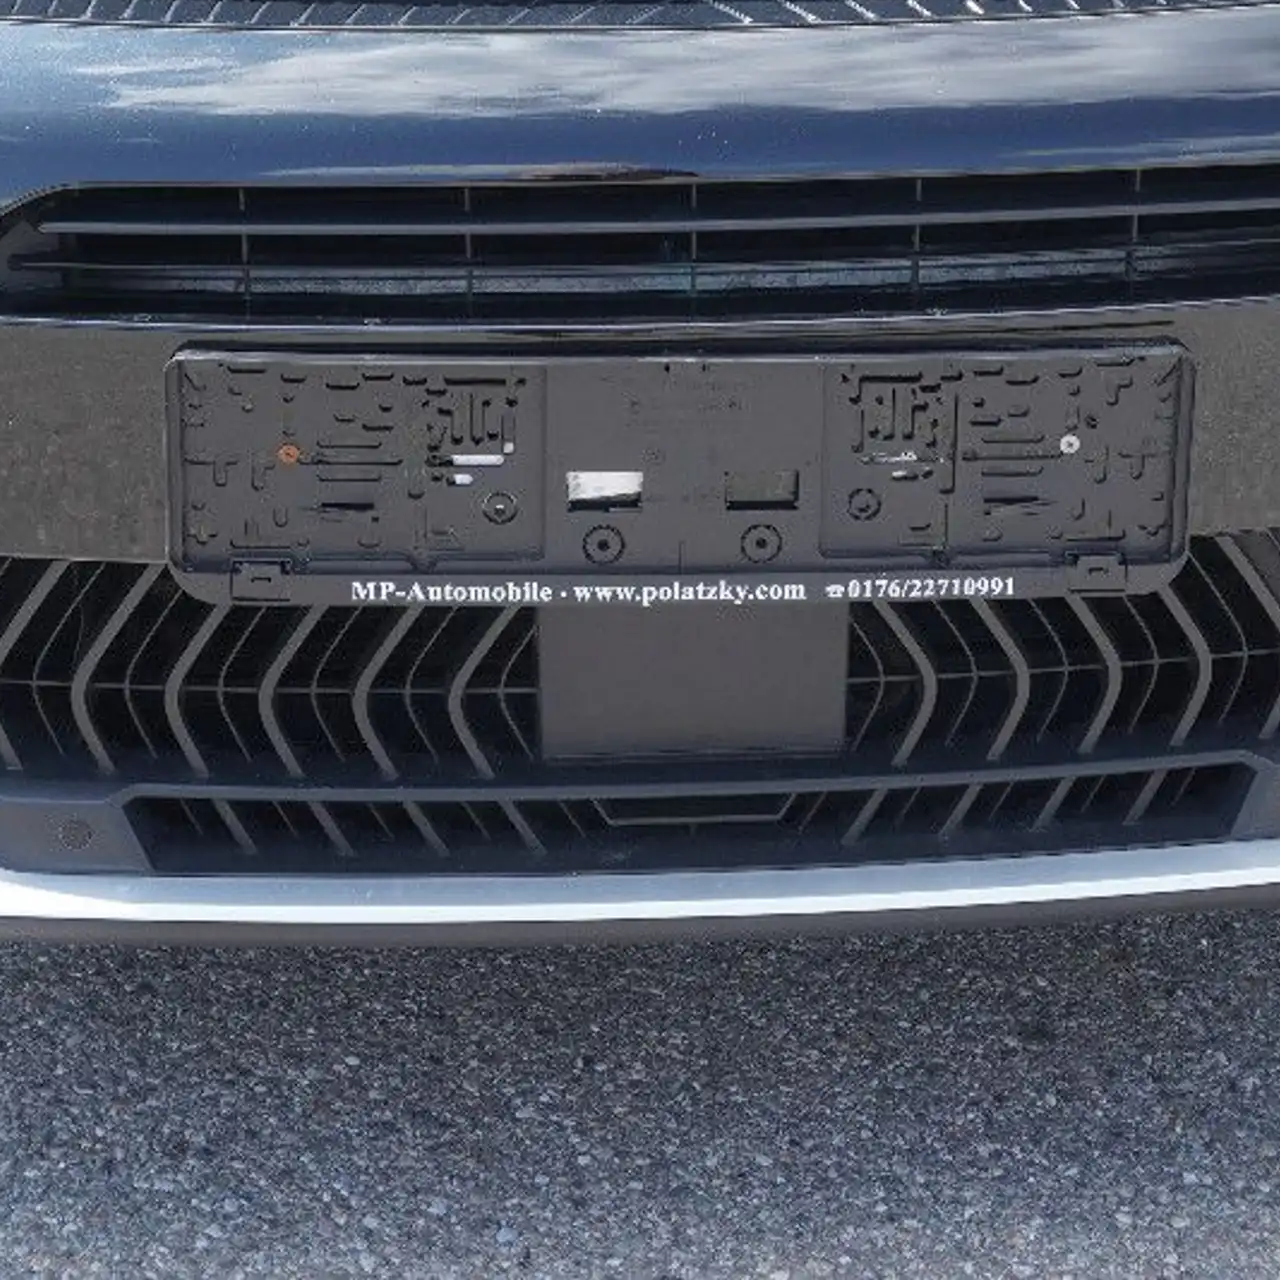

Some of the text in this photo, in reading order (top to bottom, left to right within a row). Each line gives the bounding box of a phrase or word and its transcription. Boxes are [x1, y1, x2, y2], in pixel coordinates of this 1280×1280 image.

[351, 576, 1014, 607] MP-Automobile www.polatzky.com 0176/22710991
